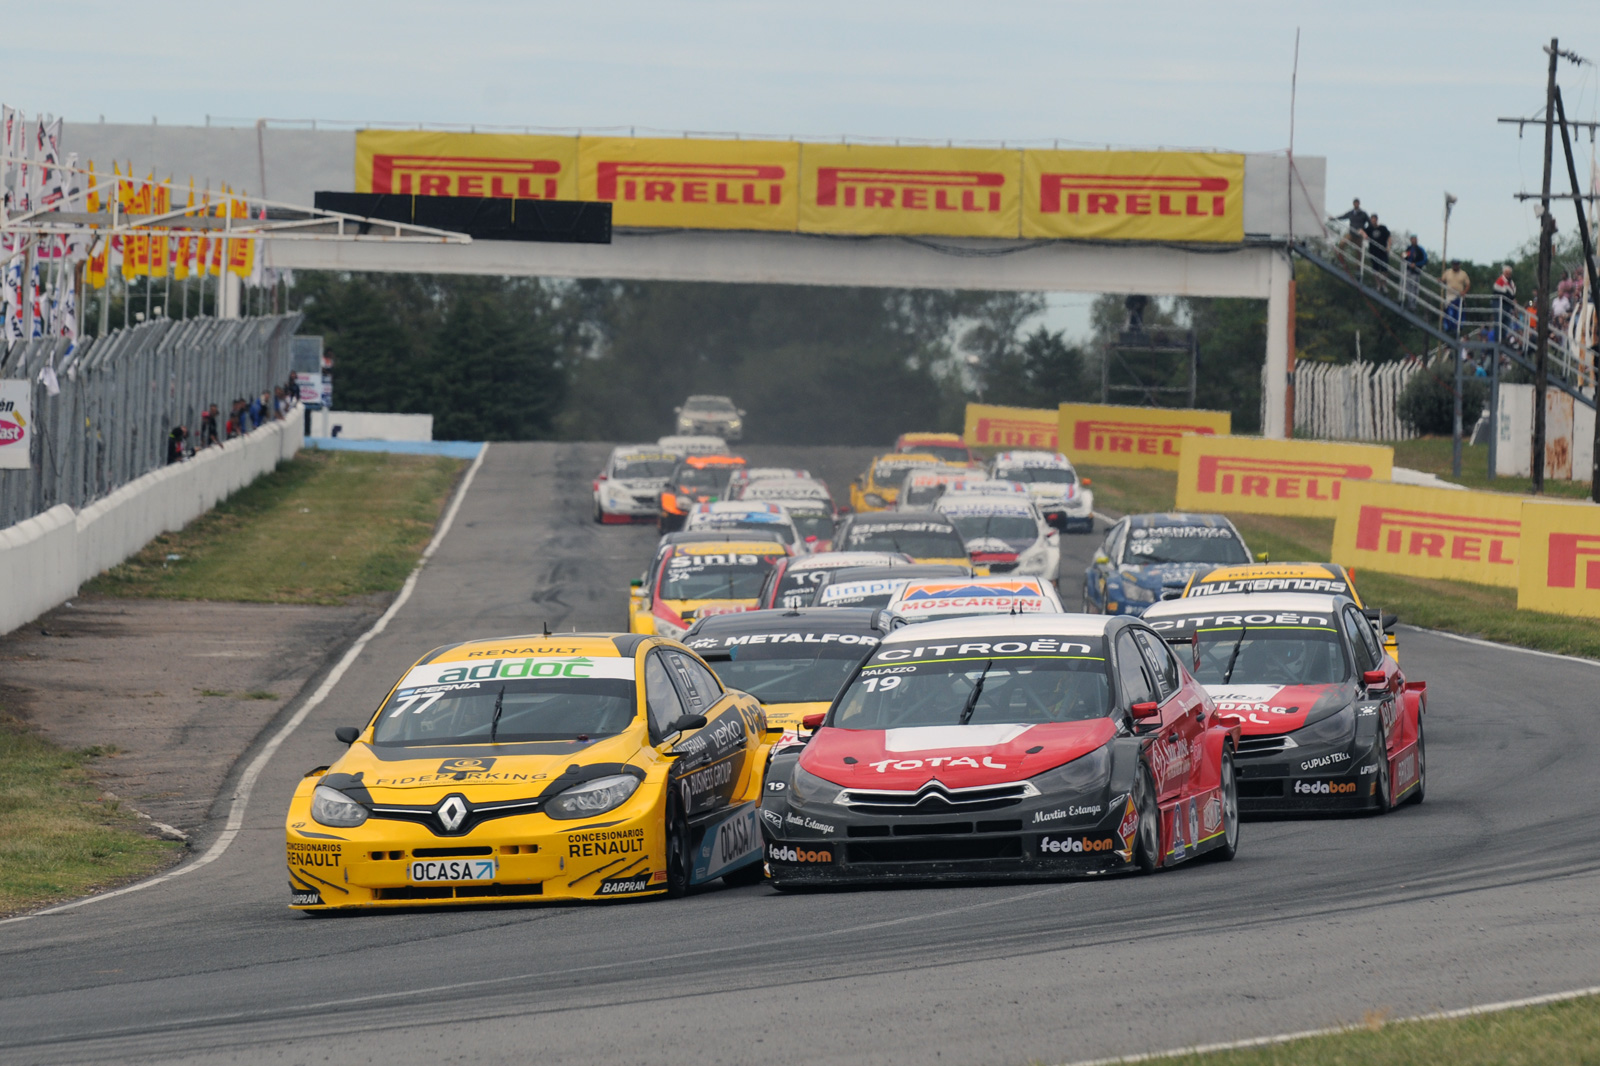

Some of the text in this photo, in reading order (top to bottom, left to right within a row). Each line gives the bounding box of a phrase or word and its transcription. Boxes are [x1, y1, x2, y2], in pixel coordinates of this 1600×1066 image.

[373, 154, 561, 198] PIRELLI
[598, 161, 786, 205] PIRELLI
[817, 167, 1005, 212] PIRELLI
[1040, 173, 1229, 217] PIRELLI
[1356, 505, 1521, 564] PIREL
[1189, 579, 1347, 597] MULTIBANDAS
[901, 598, 1042, 611] MOSCARDINI
[724, 633, 880, 647] METALFOR
[468, 647, 582, 658] RENAULT
[437, 657, 595, 684] addoc
[861, 665, 917, 677] PALAZZO
[413, 682, 481, 695] PERNIA
[862, 675, 902, 693] 19
[389, 691, 445, 718] 77
[870, 755, 1007, 773] TOTAL
[768, 782, 785, 791] 19
[1294, 780, 1356, 794] fedabom
[1032, 804, 1101, 824] Martin Estanga
[804, 816, 835, 834] Estanga
[568, 828, 644, 843] CONCESIONARIOS
[721, 814, 749, 864] OCASA
[1041, 836, 1113, 853] fedabom
[569, 838, 644, 858] RENAULT
[769, 843, 832, 862] fedabom
[287, 852, 342, 867] RENAULT
[413, 862, 473, 881] OCASA
[602, 881, 646, 893] BARPRAN
